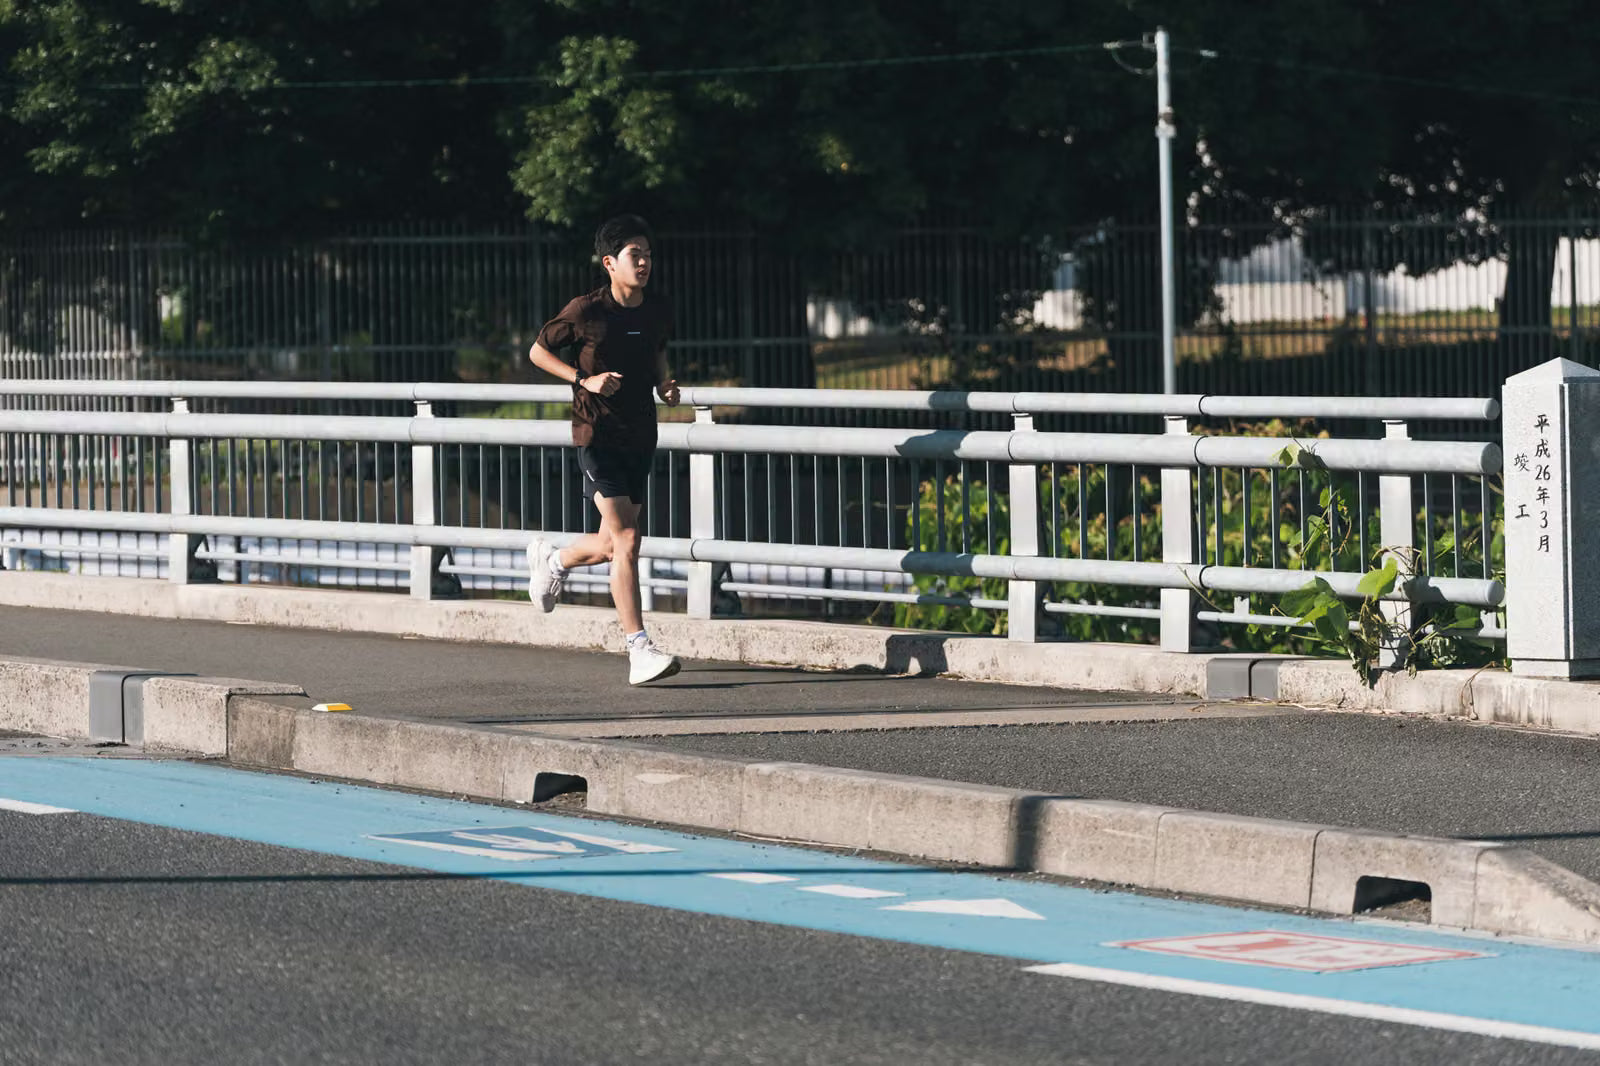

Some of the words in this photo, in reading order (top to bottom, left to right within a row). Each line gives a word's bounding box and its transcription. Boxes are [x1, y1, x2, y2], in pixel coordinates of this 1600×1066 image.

[1514, 452, 1530, 519] 竣工
[1534, 414, 1551, 553] 平成26年3月
